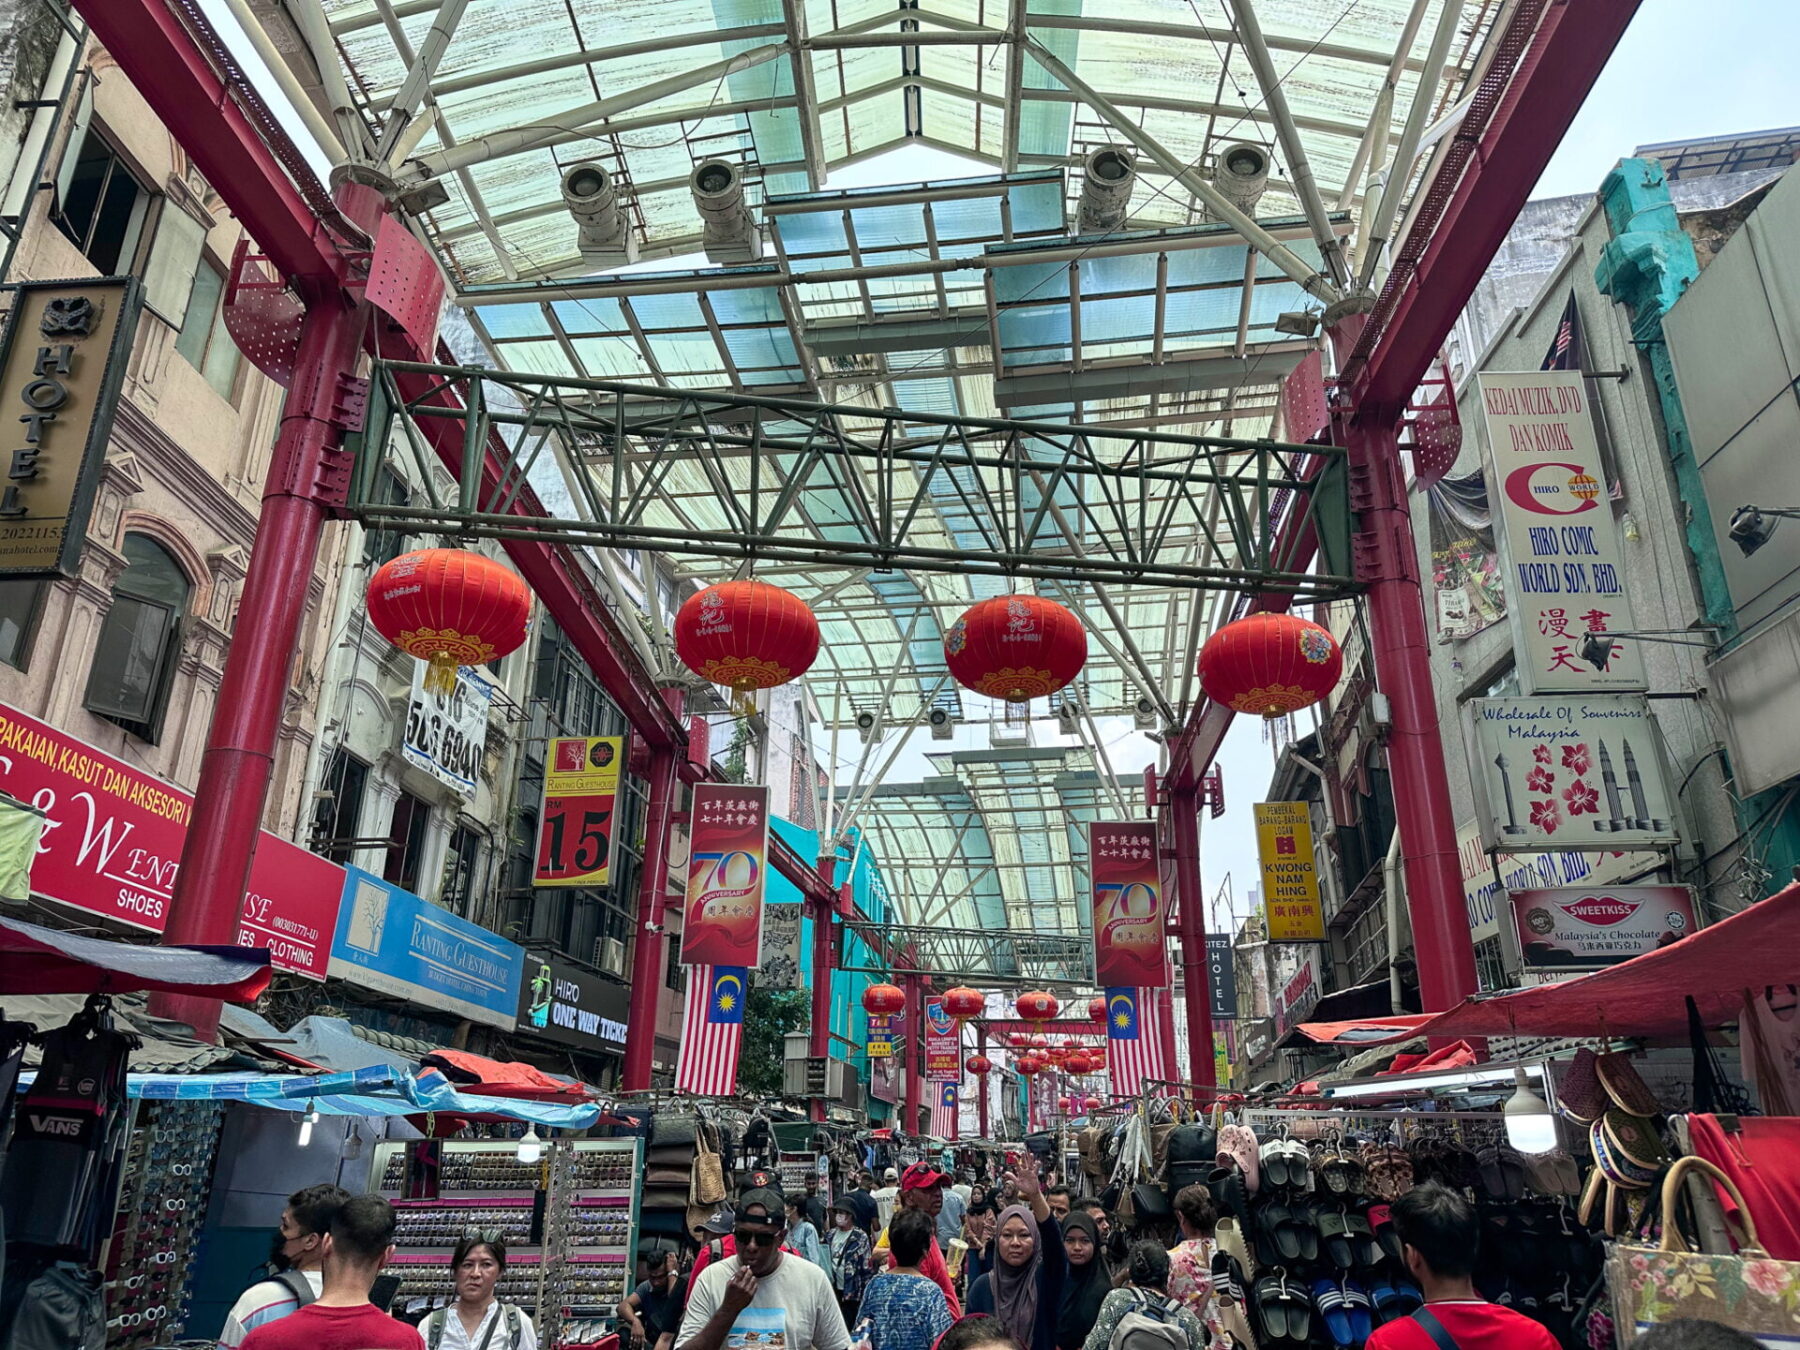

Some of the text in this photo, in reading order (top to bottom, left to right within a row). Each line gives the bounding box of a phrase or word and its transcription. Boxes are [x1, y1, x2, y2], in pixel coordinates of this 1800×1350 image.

[1484, 387, 1519, 415] KEDAI
[1556, 385, 1582, 414] DVD
[0, 344, 75, 516] HOTEL
[1508, 422, 1574, 452] DAN KOMIK
[1534, 485, 1560, 494] HIRO
[1568, 482, 1600, 492] WORLD
[1528, 525, 1600, 556] HIRO COMIC
[1517, 563, 1623, 594] WORLD SDN. BHD.
[1483, 705, 1642, 723] Wholesale Of Souvenirs
[1508, 724, 1580, 743] Malaysia
[57, 746, 104, 787] KASUT
[102, 767, 131, 800] DAN
[128, 781, 186, 825] AKSESORI
[547, 778, 615, 789] RANTING GUESTHOUSE
[546, 800, 562, 809] RM
[1267, 805, 1296, 816] PEMBEKAL
[1259, 815, 1307, 826] BARANG-BARANG
[1275, 825, 1294, 836] LOGAM
[540, 811, 612, 872] 15
[692, 850, 758, 893] 70
[1265, 862, 1312, 873] KWONG
[1276, 874, 1304, 884] NAM
[700, 890, 745, 905] ANNIVERSARY
[1095, 882, 1158, 919] 70
[1276, 886, 1307, 897] HING
[117, 888, 164, 918] SHOES
[1570, 904, 1632, 916] SWEETKISS
[1555, 929, 1660, 943] Malaysia's Chocolate
[266, 938, 314, 967] CLOTHING
[410, 921, 451, 963] RANTING
[453, 941, 509, 985] GUESTHOUSE
[554, 978, 580, 1003] HIRO
[1211, 952, 1225, 1011] HOTEL
[552, 1002, 628, 1044] ONE WAY TICKE
[29, 1114, 84, 1136] VANS
